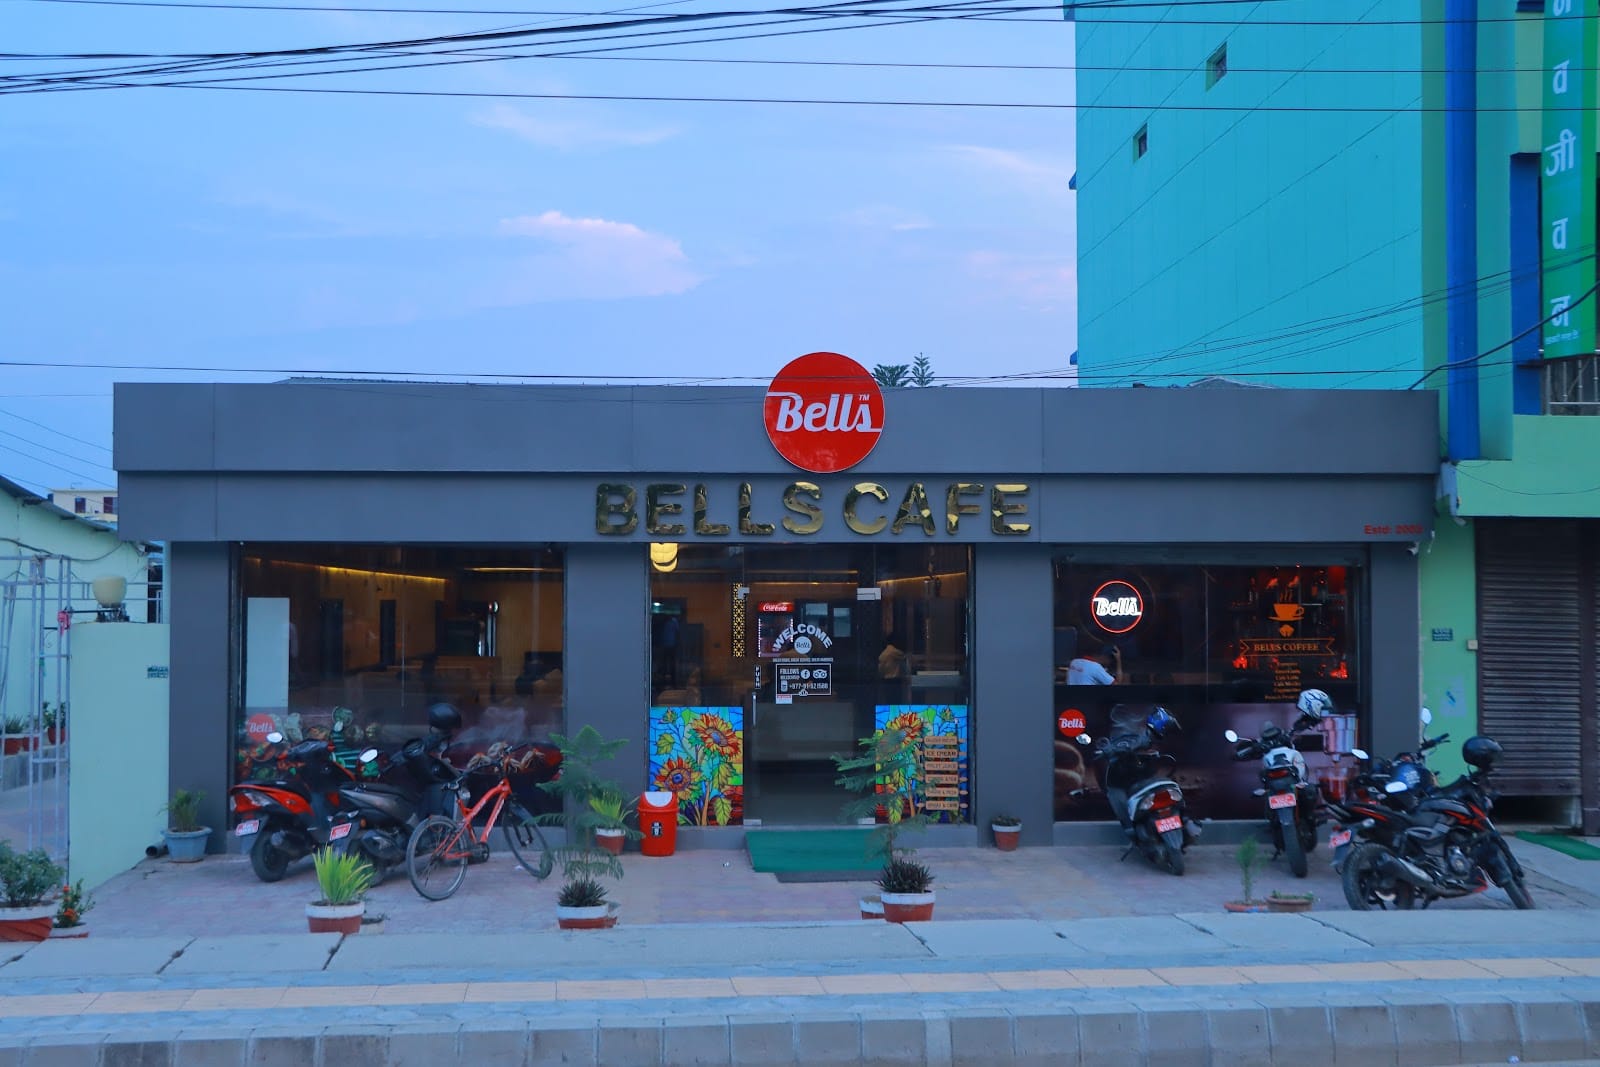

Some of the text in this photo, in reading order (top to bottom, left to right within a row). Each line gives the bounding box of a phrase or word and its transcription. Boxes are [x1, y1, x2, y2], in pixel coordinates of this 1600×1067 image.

[767, 392, 882, 432] Bells
[595, 481, 1032, 536] BELLS CAFE
[1093, 597, 1142, 616] Bells
[772, 623, 833, 652] WELCOME
[1283, 643, 1319, 651] COFFEE
[1058, 717, 1086, 729] Bells
